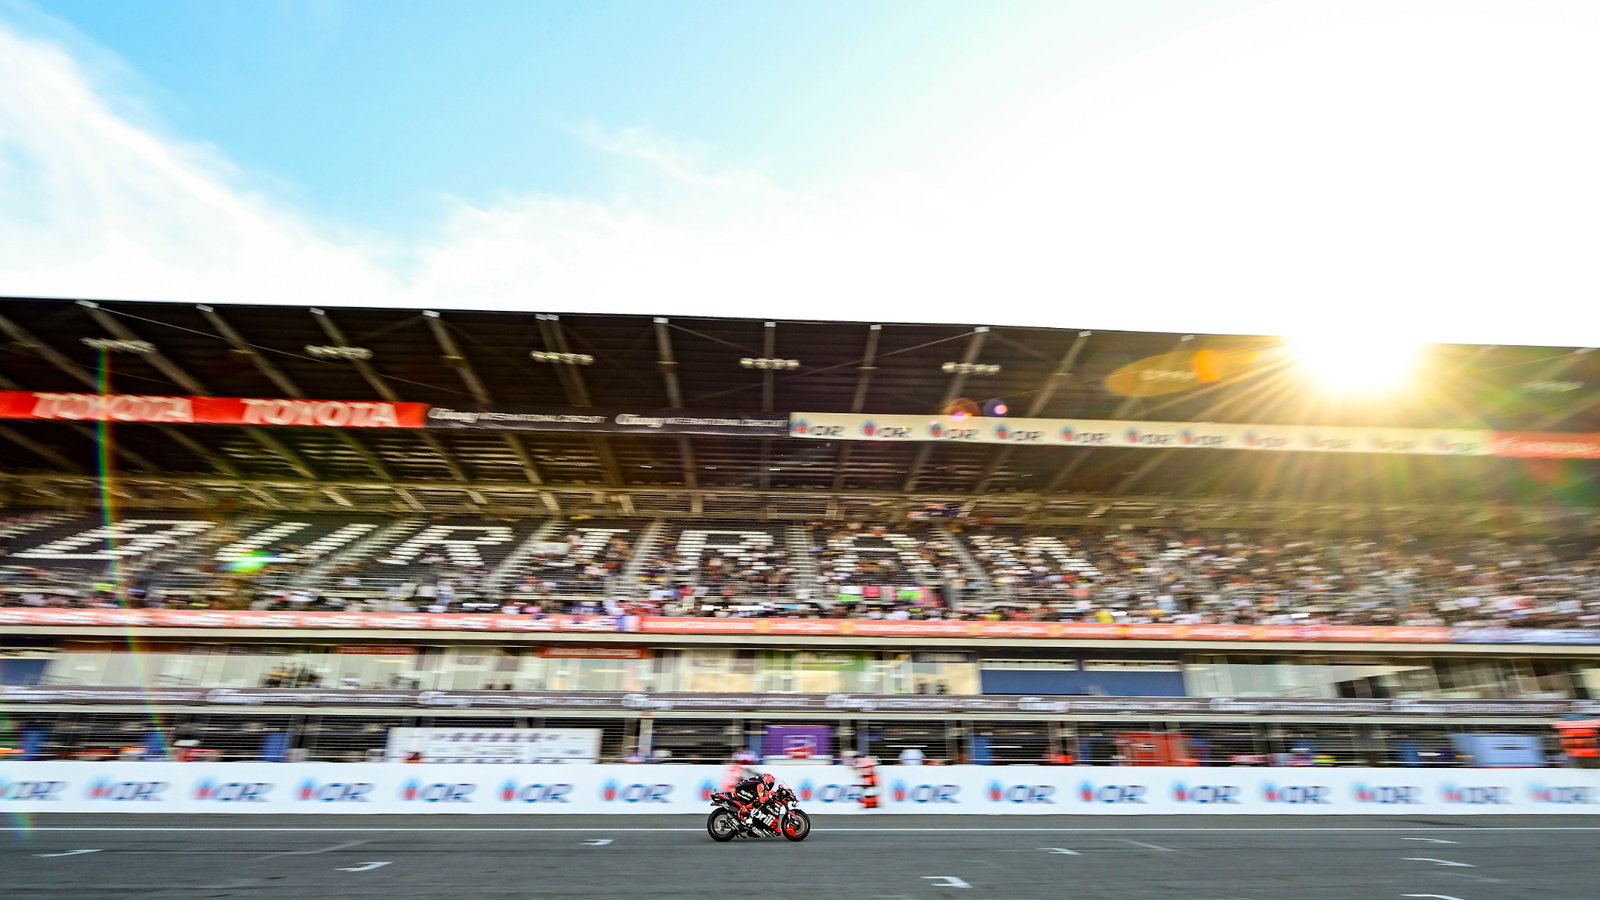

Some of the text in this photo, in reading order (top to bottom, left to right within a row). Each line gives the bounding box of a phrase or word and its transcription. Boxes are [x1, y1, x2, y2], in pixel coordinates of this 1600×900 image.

[240, 398, 398, 427] TOYOTA
[422, 783, 478, 803] OR
[521, 783, 574, 803] OR
[622, 783, 674, 803] OR
[911, 784, 960, 803] OR
[1008, 784, 1057, 804] OR
